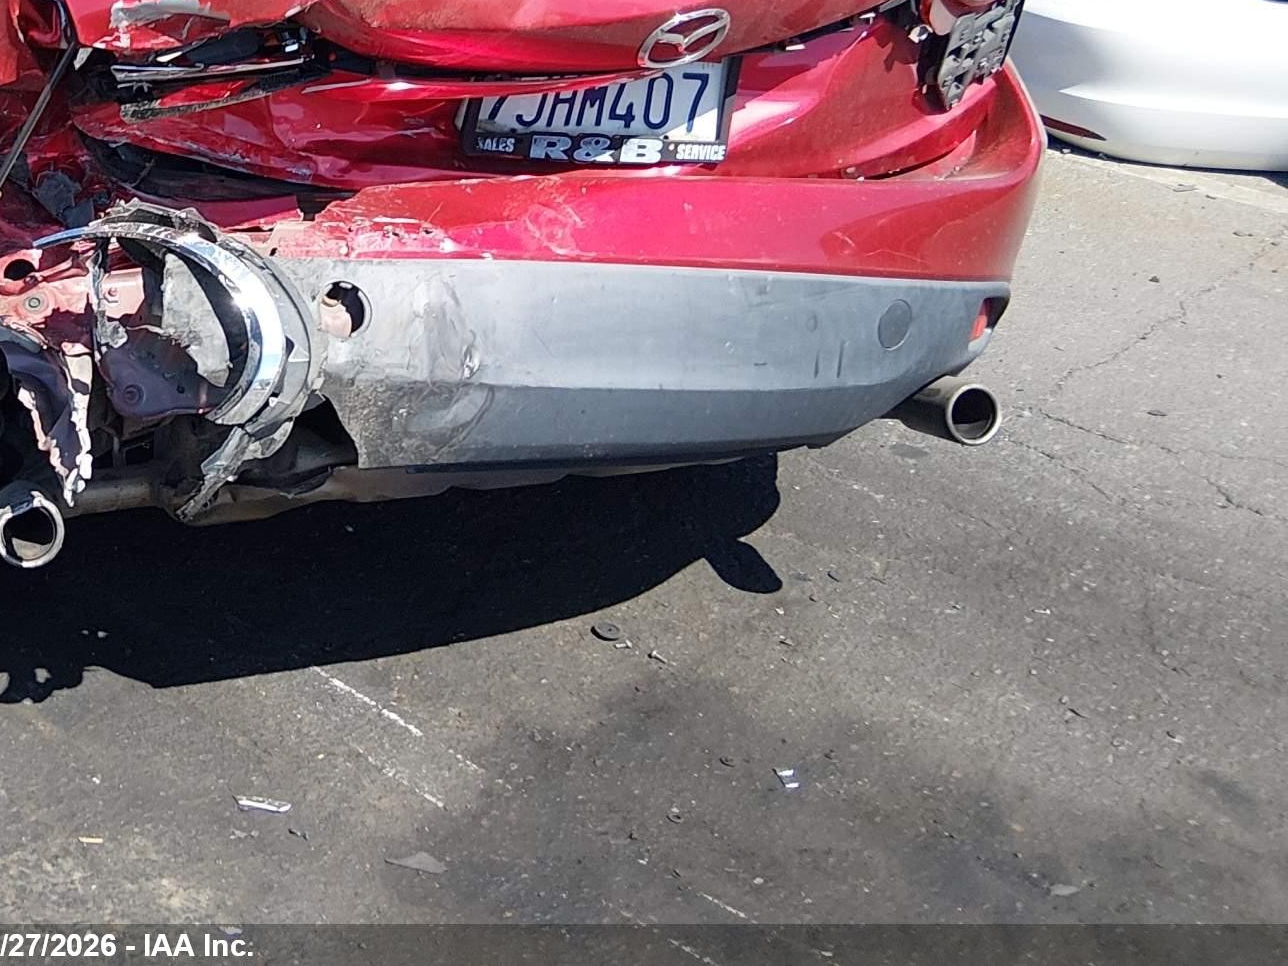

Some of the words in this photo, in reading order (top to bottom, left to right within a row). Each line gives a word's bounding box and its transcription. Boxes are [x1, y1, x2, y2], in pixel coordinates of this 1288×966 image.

[476, 136, 516, 154] SALES
[528, 134, 664, 163] R&B
[675, 143, 726, 161] SERVICE
